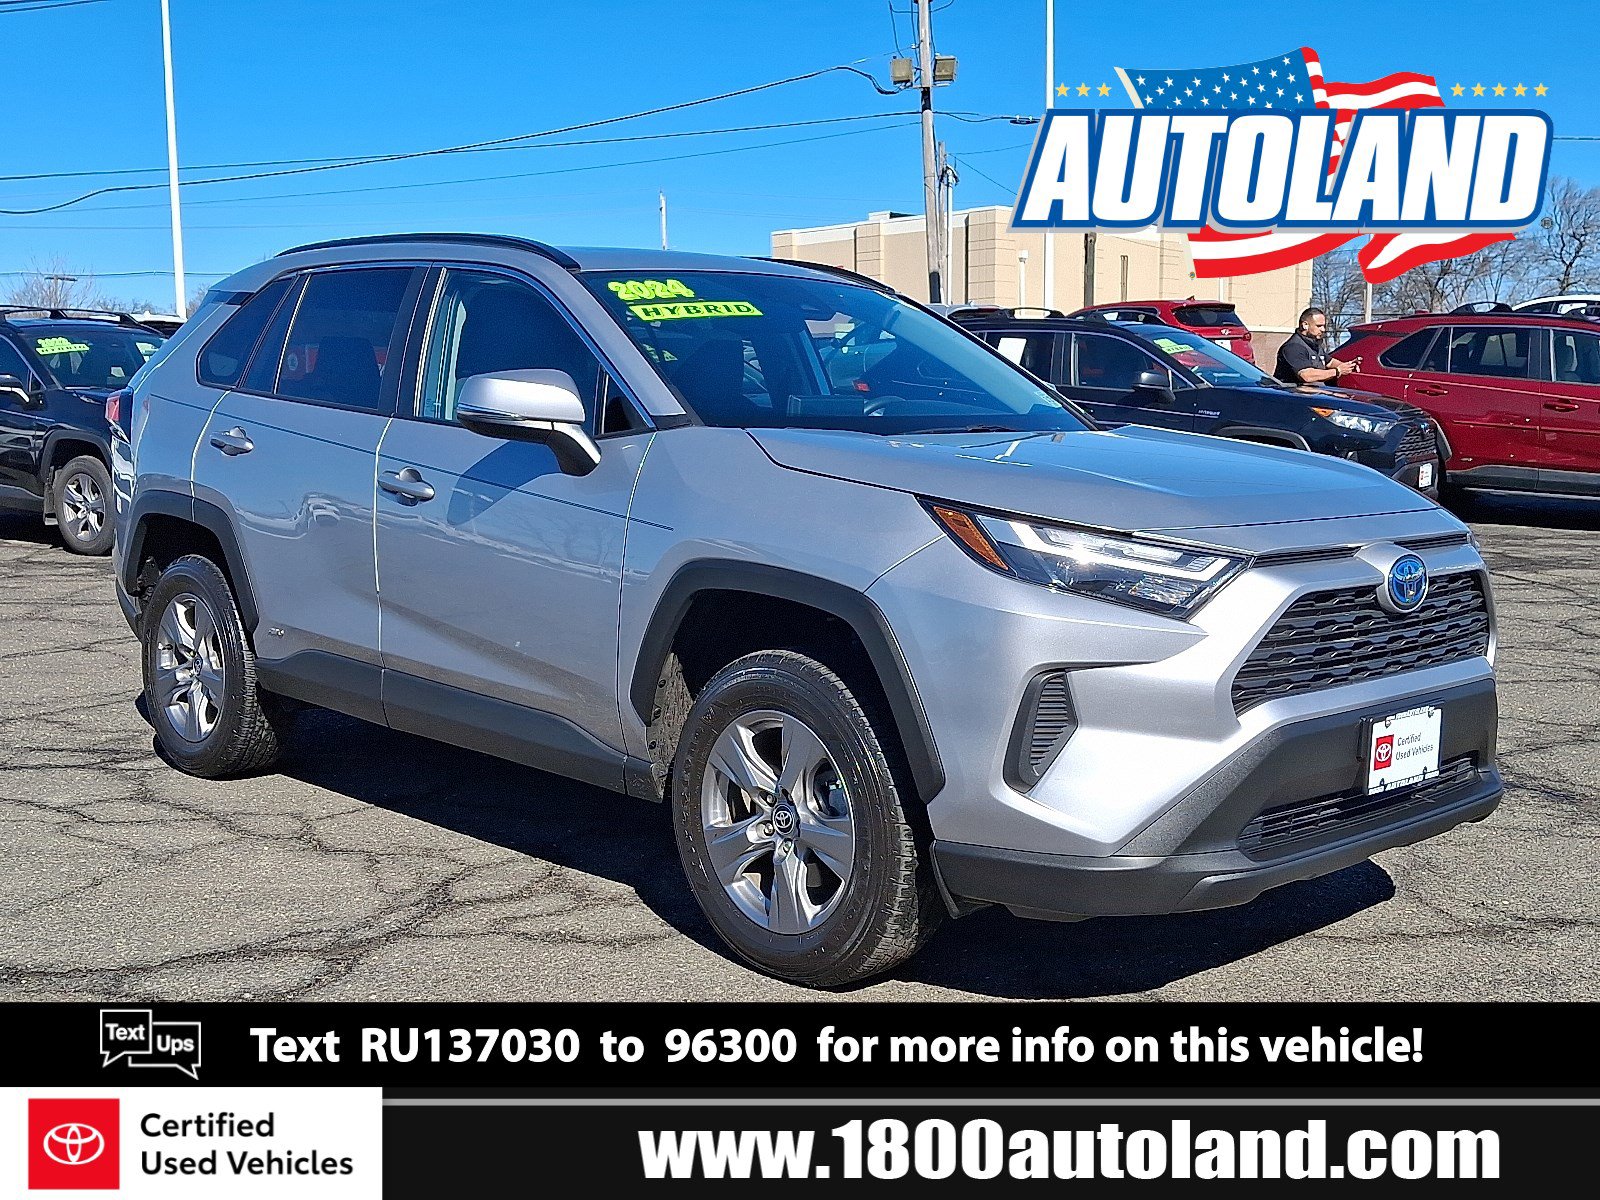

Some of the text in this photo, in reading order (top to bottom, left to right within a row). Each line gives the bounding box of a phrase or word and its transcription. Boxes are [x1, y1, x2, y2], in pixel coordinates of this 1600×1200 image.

[608, 279, 694, 300] 2024
[640, 303, 753, 318] HYBRID
[1397, 731, 1422, 747] Certified
[1395, 743, 1434, 761] Used Vehicles
